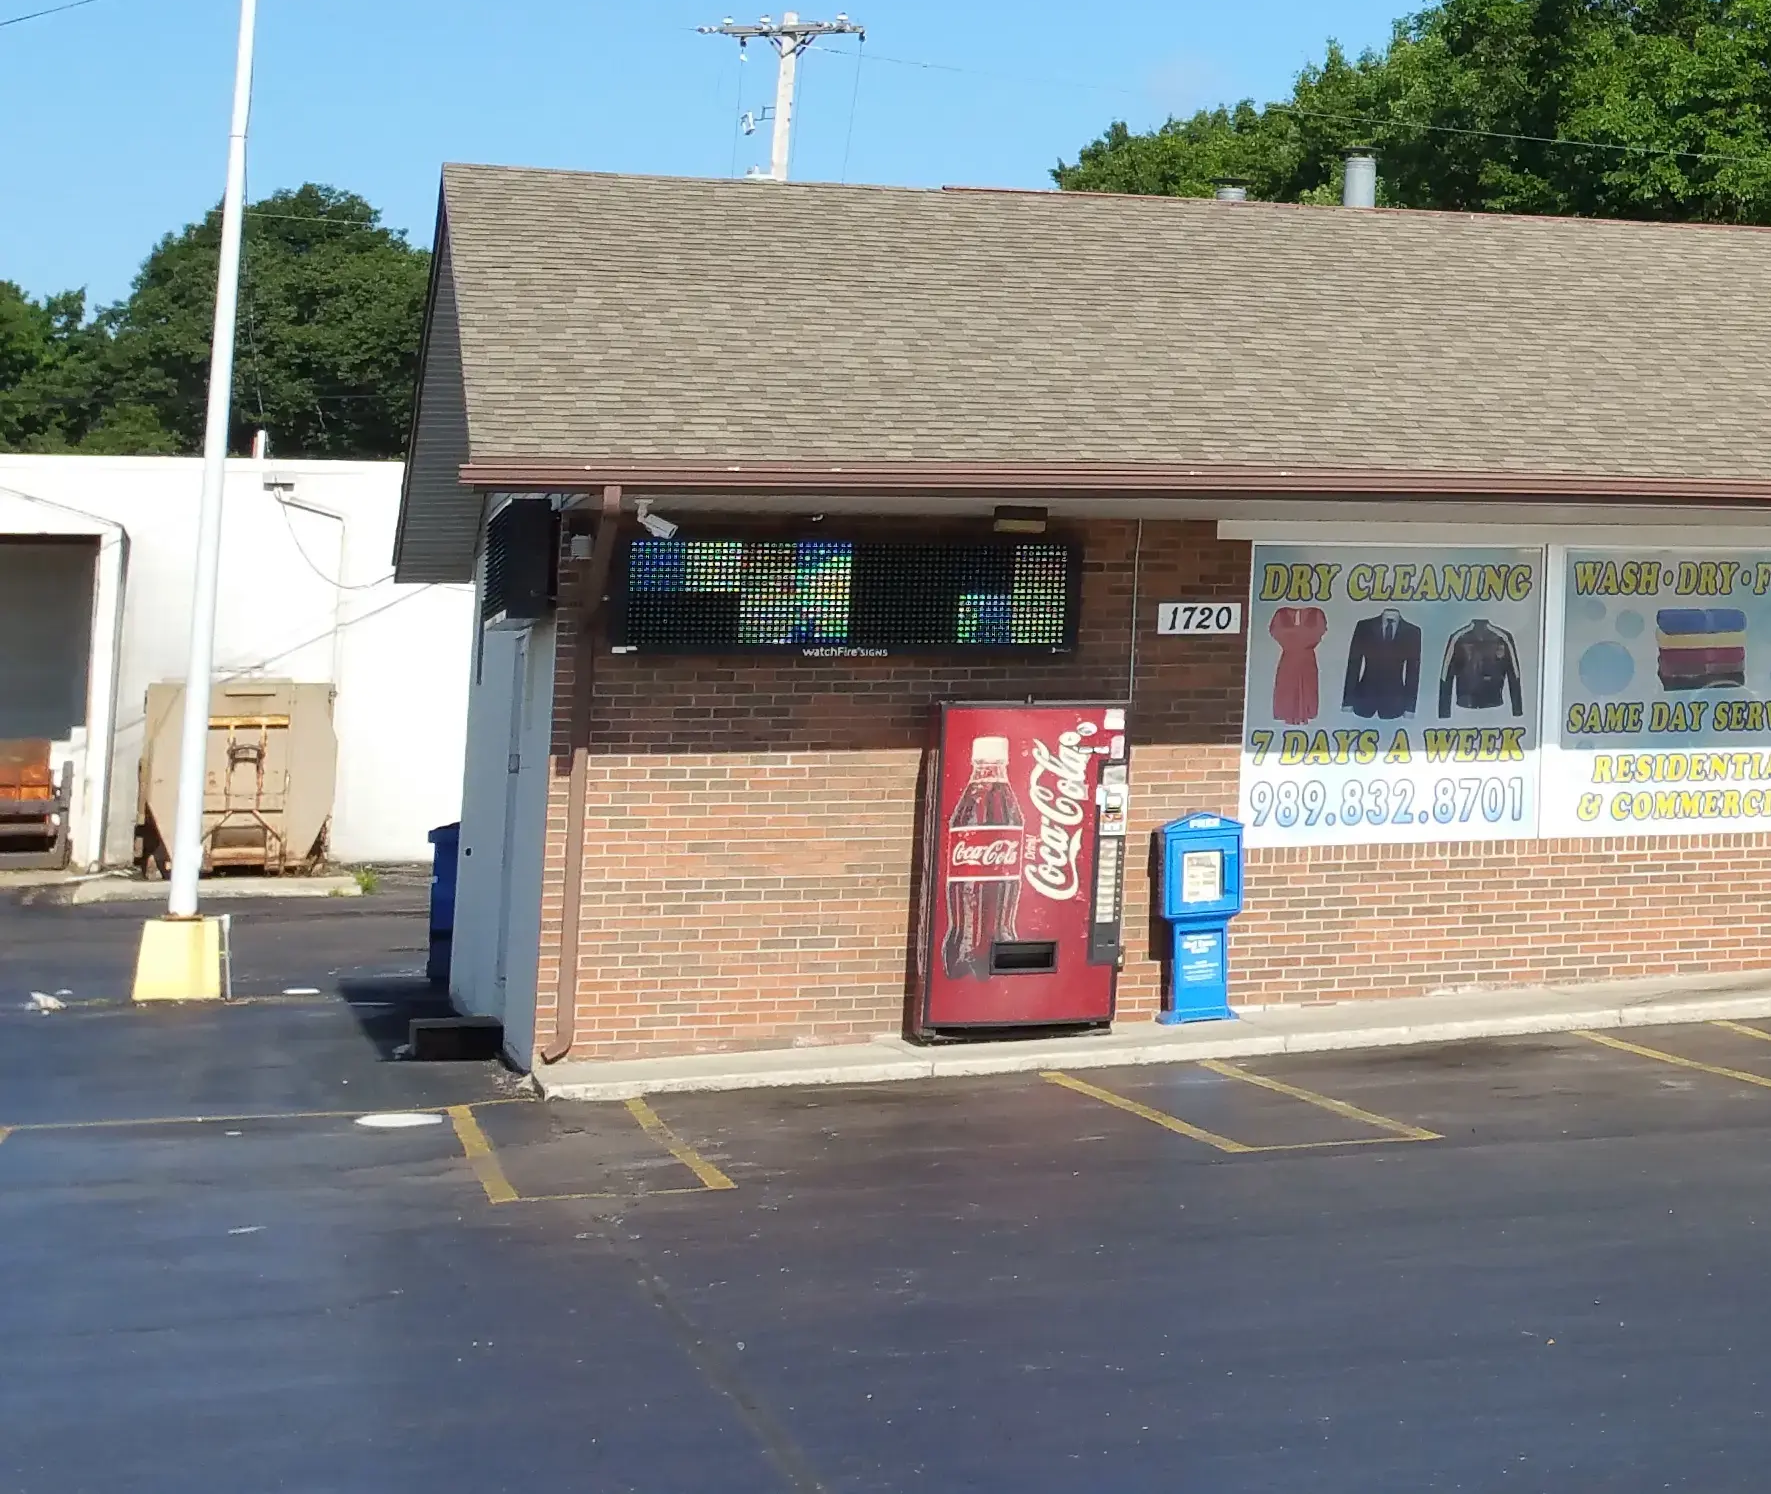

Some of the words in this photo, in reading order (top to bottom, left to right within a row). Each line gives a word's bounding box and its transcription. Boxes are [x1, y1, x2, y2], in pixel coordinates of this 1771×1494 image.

[1259, 563, 1342, 602] DRY
[1346, 563, 1532, 602] CLEANING
[1574, 561, 1662, 596] WASH
[1676, 561, 1739, 595] DRY
[1168, 606, 1232, 631] 1720
[860, 649, 888, 657] SIGNS
[1566, 702, 1645, 733] SAME
[1648, 702, 1709, 732] DAY
[1252, 730, 1274, 765] 7
[1279, 729, 1380, 766] DAYS
[1384, 729, 1412, 764] A
[1423, 727, 1526, 763] WEEK
[1250, 777, 1524, 828] 989.832.8701
[1576, 793, 1603, 821] &
